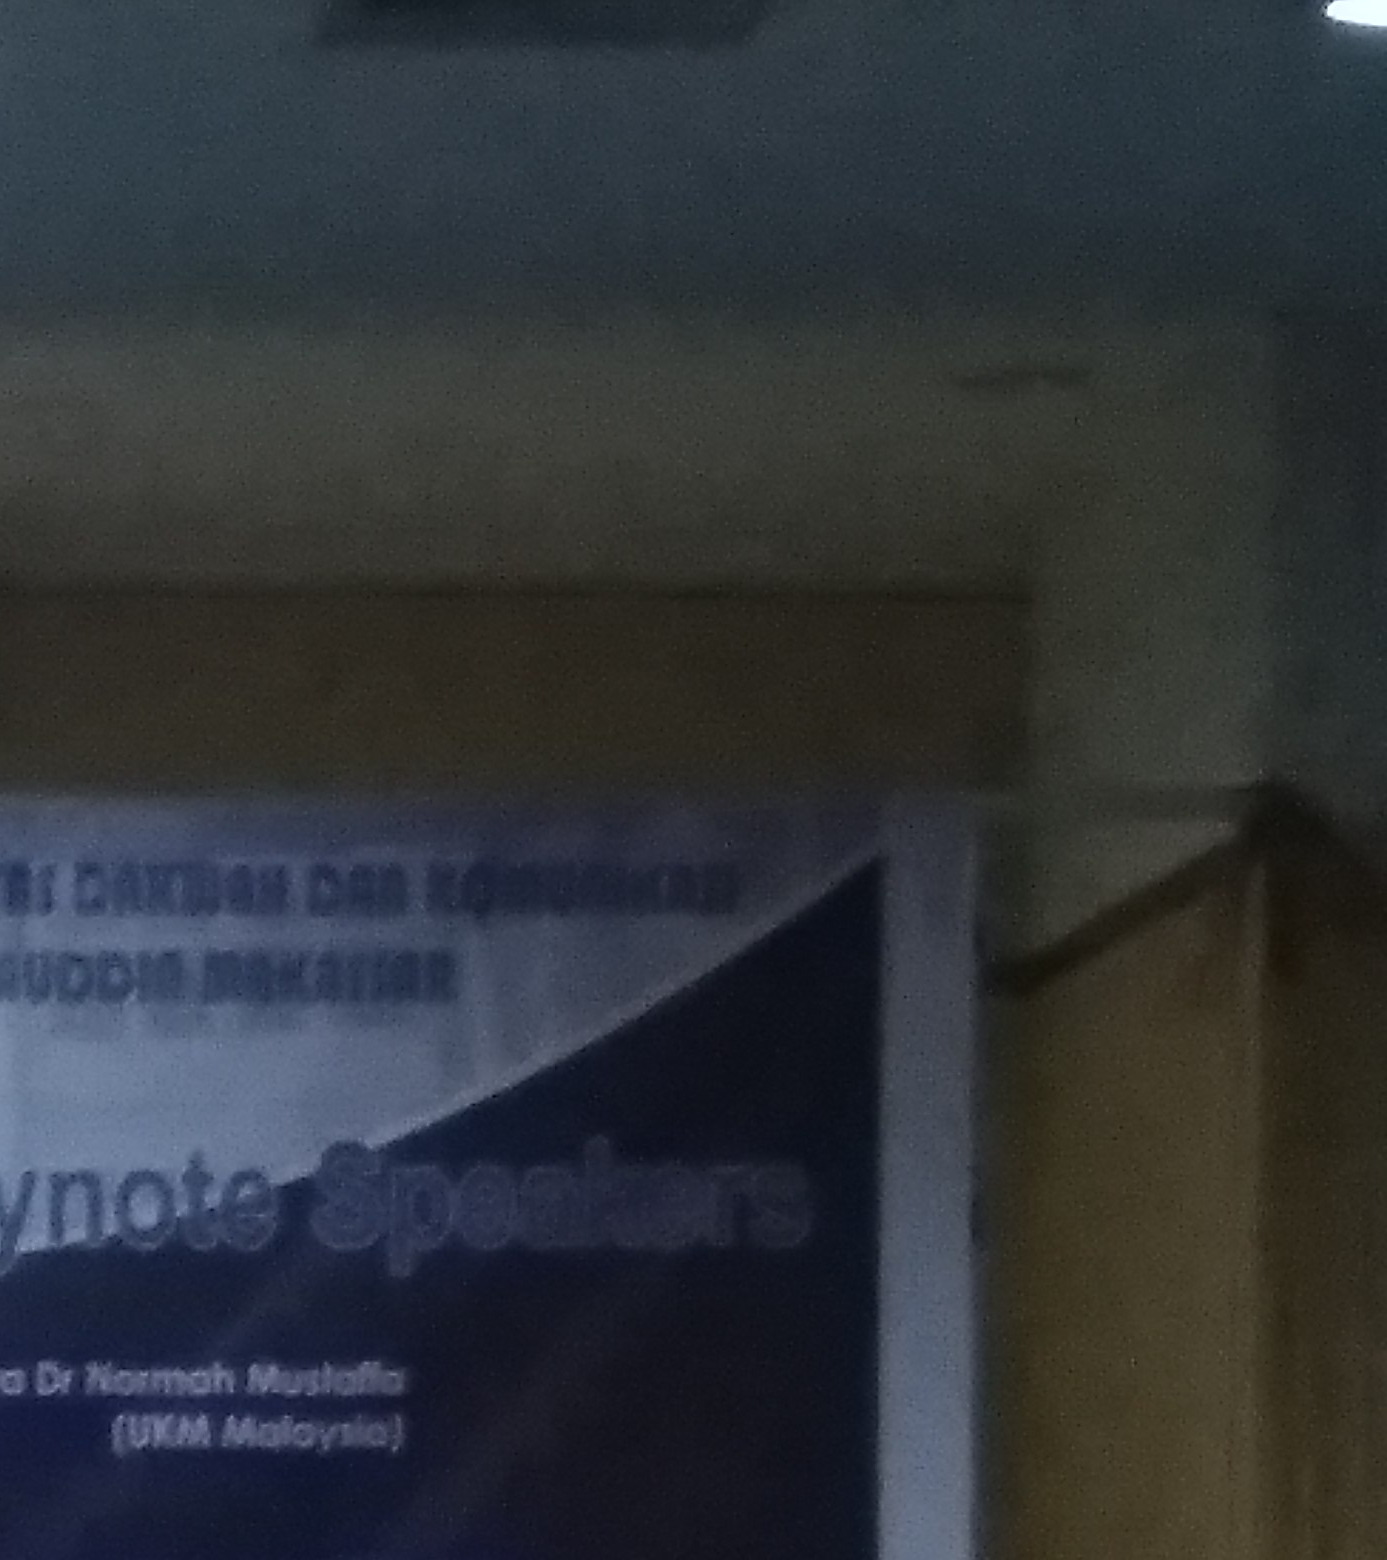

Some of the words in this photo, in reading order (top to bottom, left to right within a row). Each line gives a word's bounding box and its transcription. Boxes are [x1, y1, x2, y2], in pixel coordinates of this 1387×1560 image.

[313, 1136, 814, 1280] Speakers
[33, 1359, 73, 1396] Dr
[223, 1412, 404, 1456] Malaysia)
